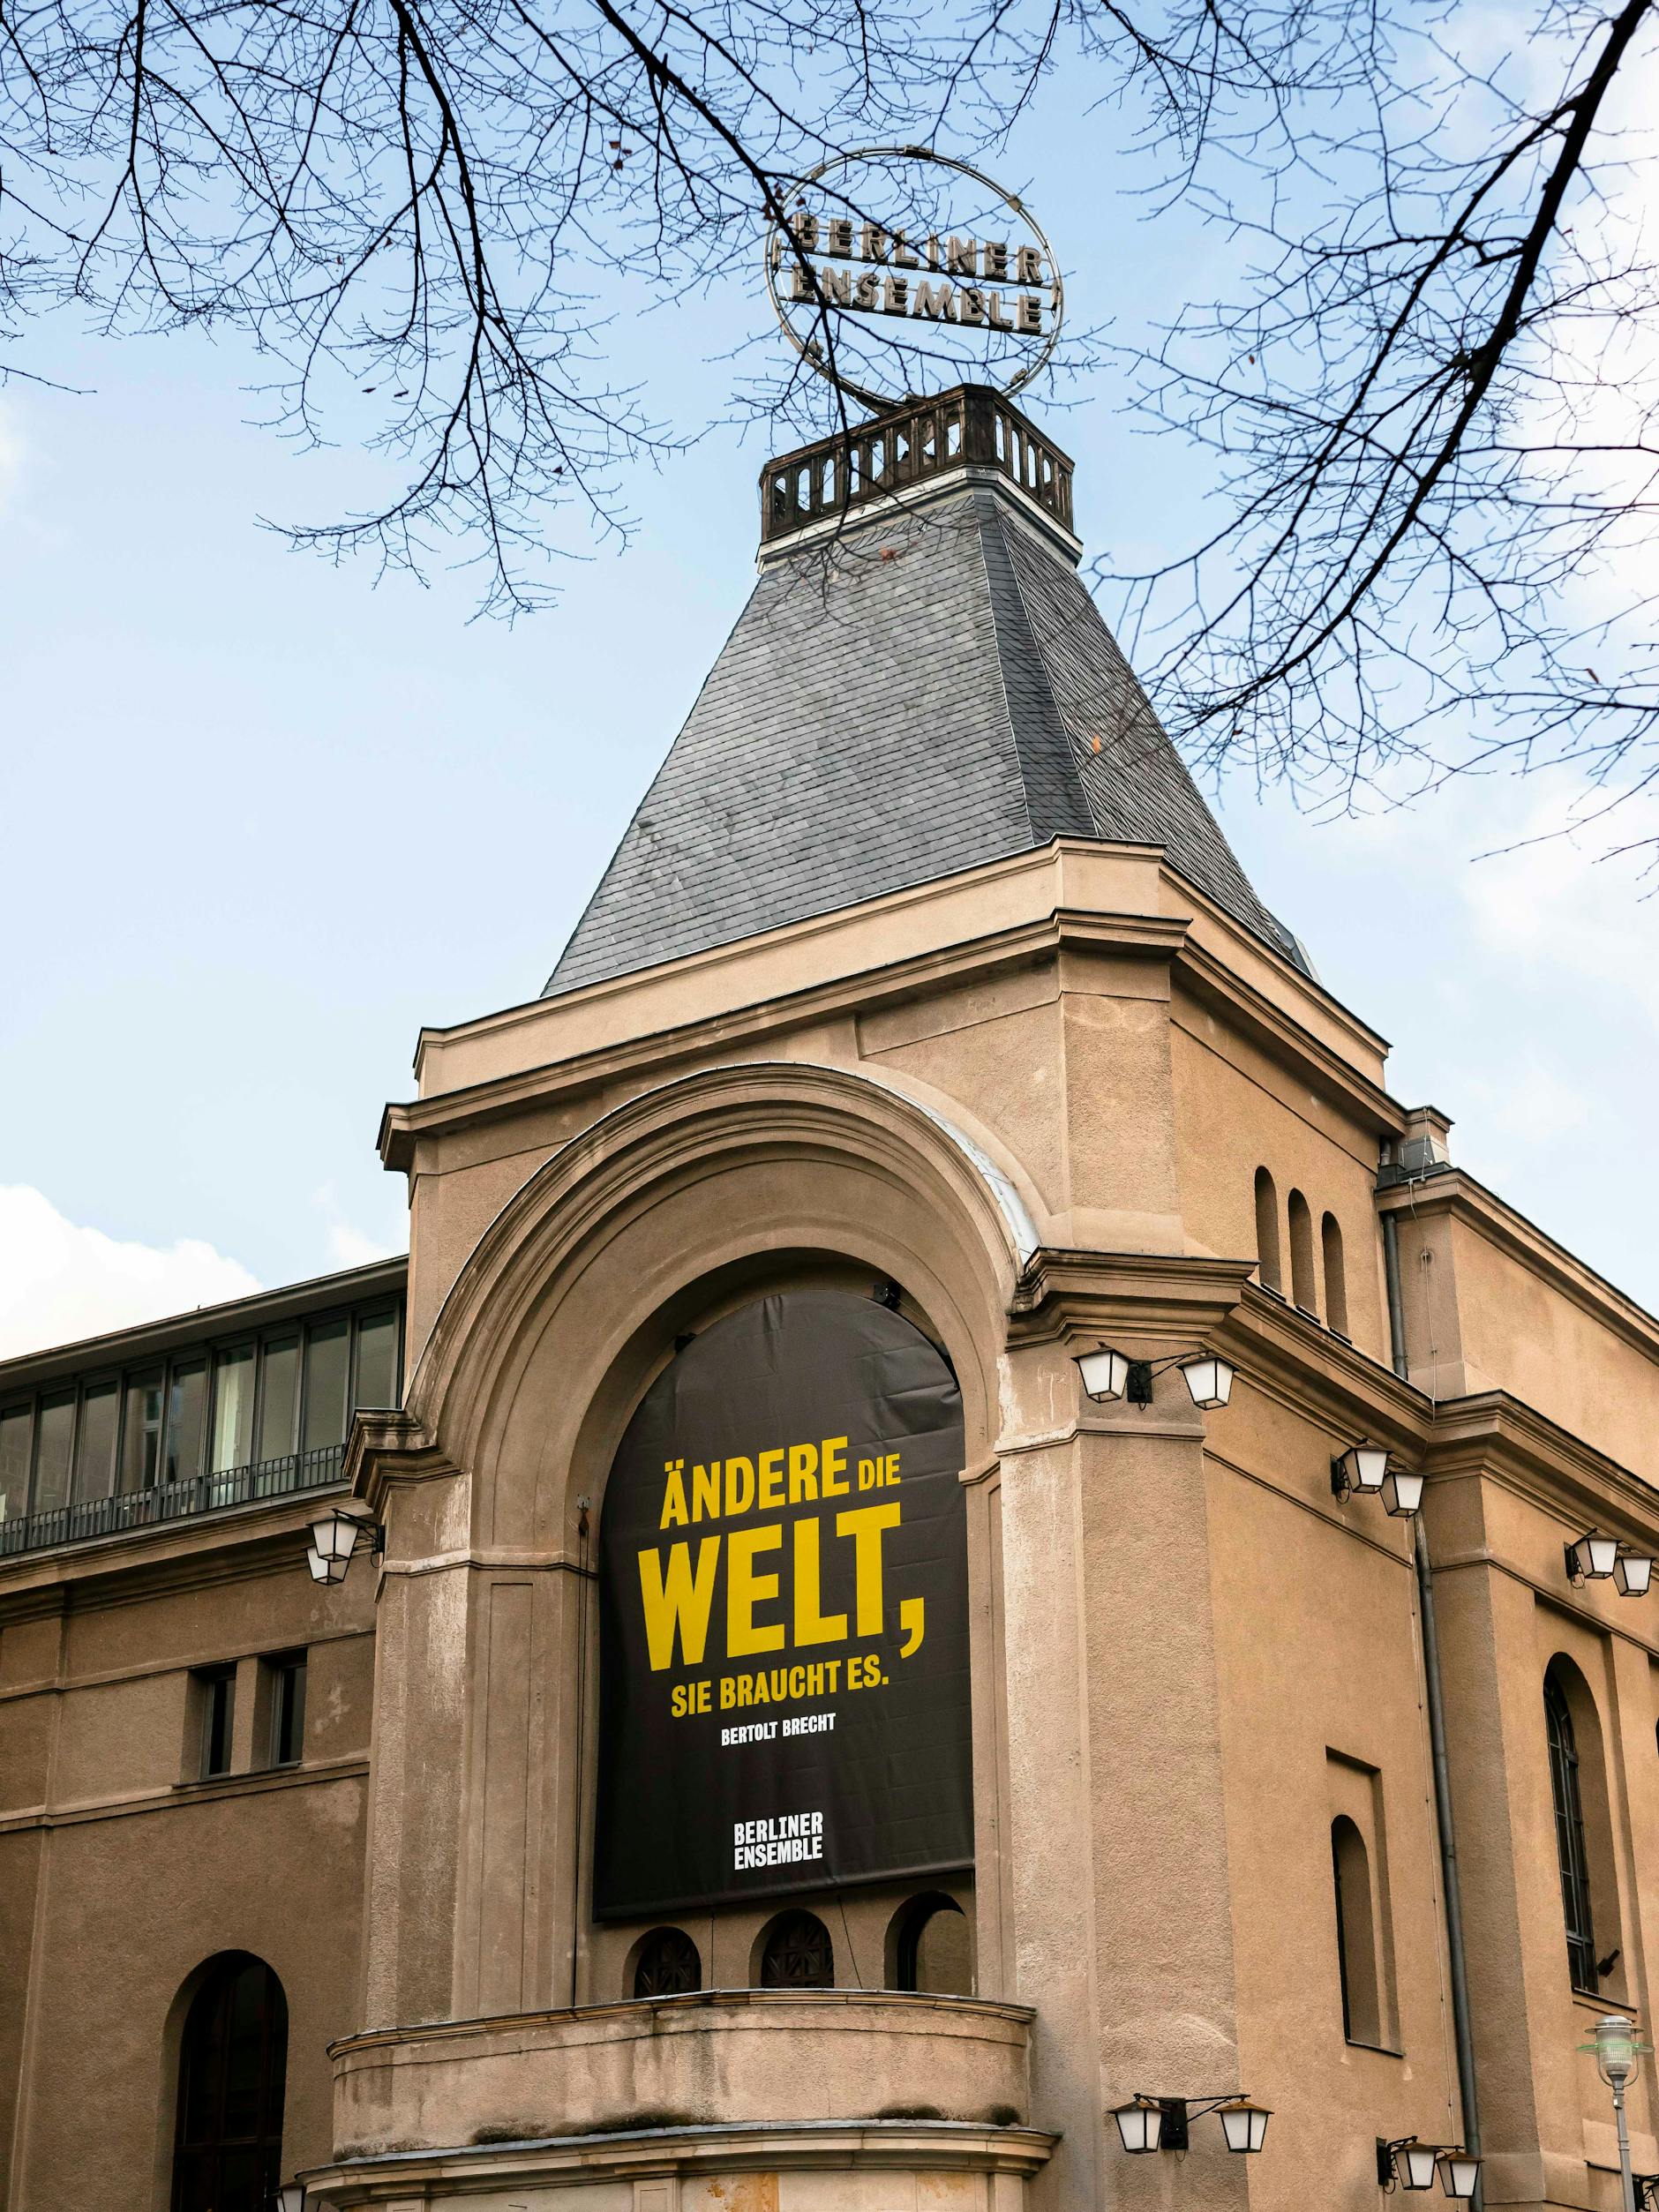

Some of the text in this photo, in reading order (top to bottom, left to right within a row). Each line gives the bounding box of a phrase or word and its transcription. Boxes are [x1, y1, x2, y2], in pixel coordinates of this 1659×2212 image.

[792, 212, 1044, 285] BERLINER
[791, 262, 1043, 334] ENSEMBLE
[659, 1436, 902, 1530] ÄNDERE DIE
[637, 1501, 925, 1672] WELT,
[671, 1653, 890, 1718] SIE BRAUCHT ES.
[721, 1712, 837, 1747] BERTOLT BRECHT
[733, 1811, 823, 1846] BERLINER
[734, 1835, 823, 1871] ENSEMBLE
